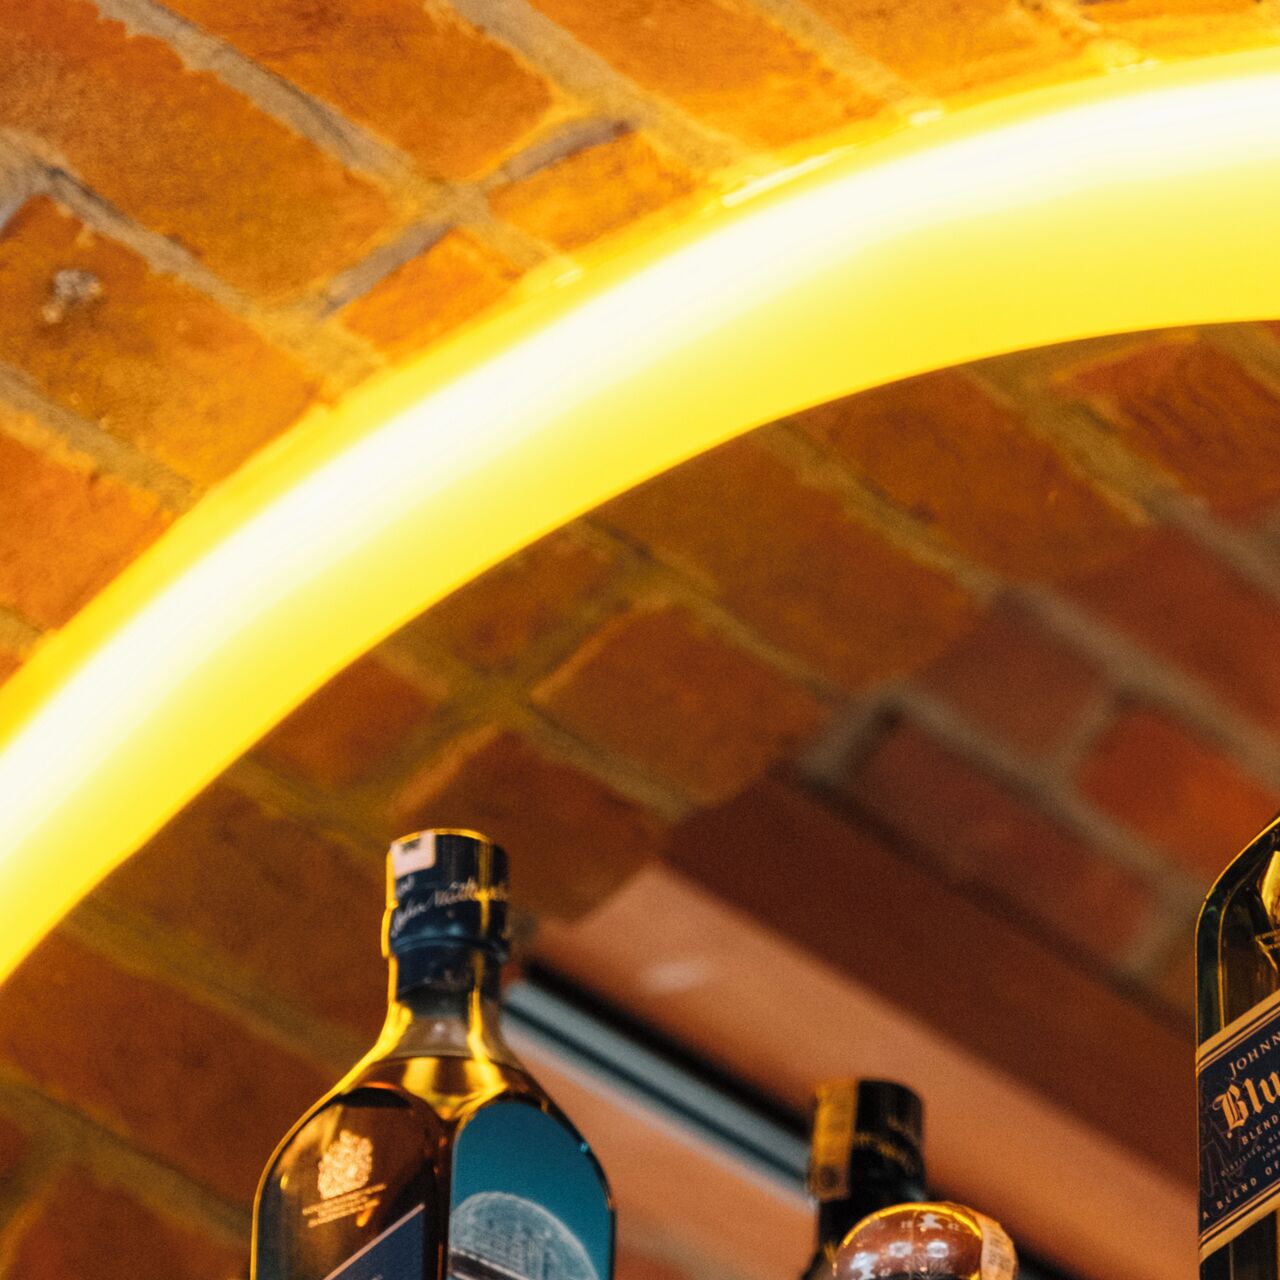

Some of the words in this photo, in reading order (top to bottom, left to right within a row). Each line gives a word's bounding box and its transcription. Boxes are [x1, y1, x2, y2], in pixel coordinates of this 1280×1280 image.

[1203, 1210, 1210, 1220] A
[1216, 1177, 1257, 1210] BLEND
[1265, 1160, 1279, 1176] OF
